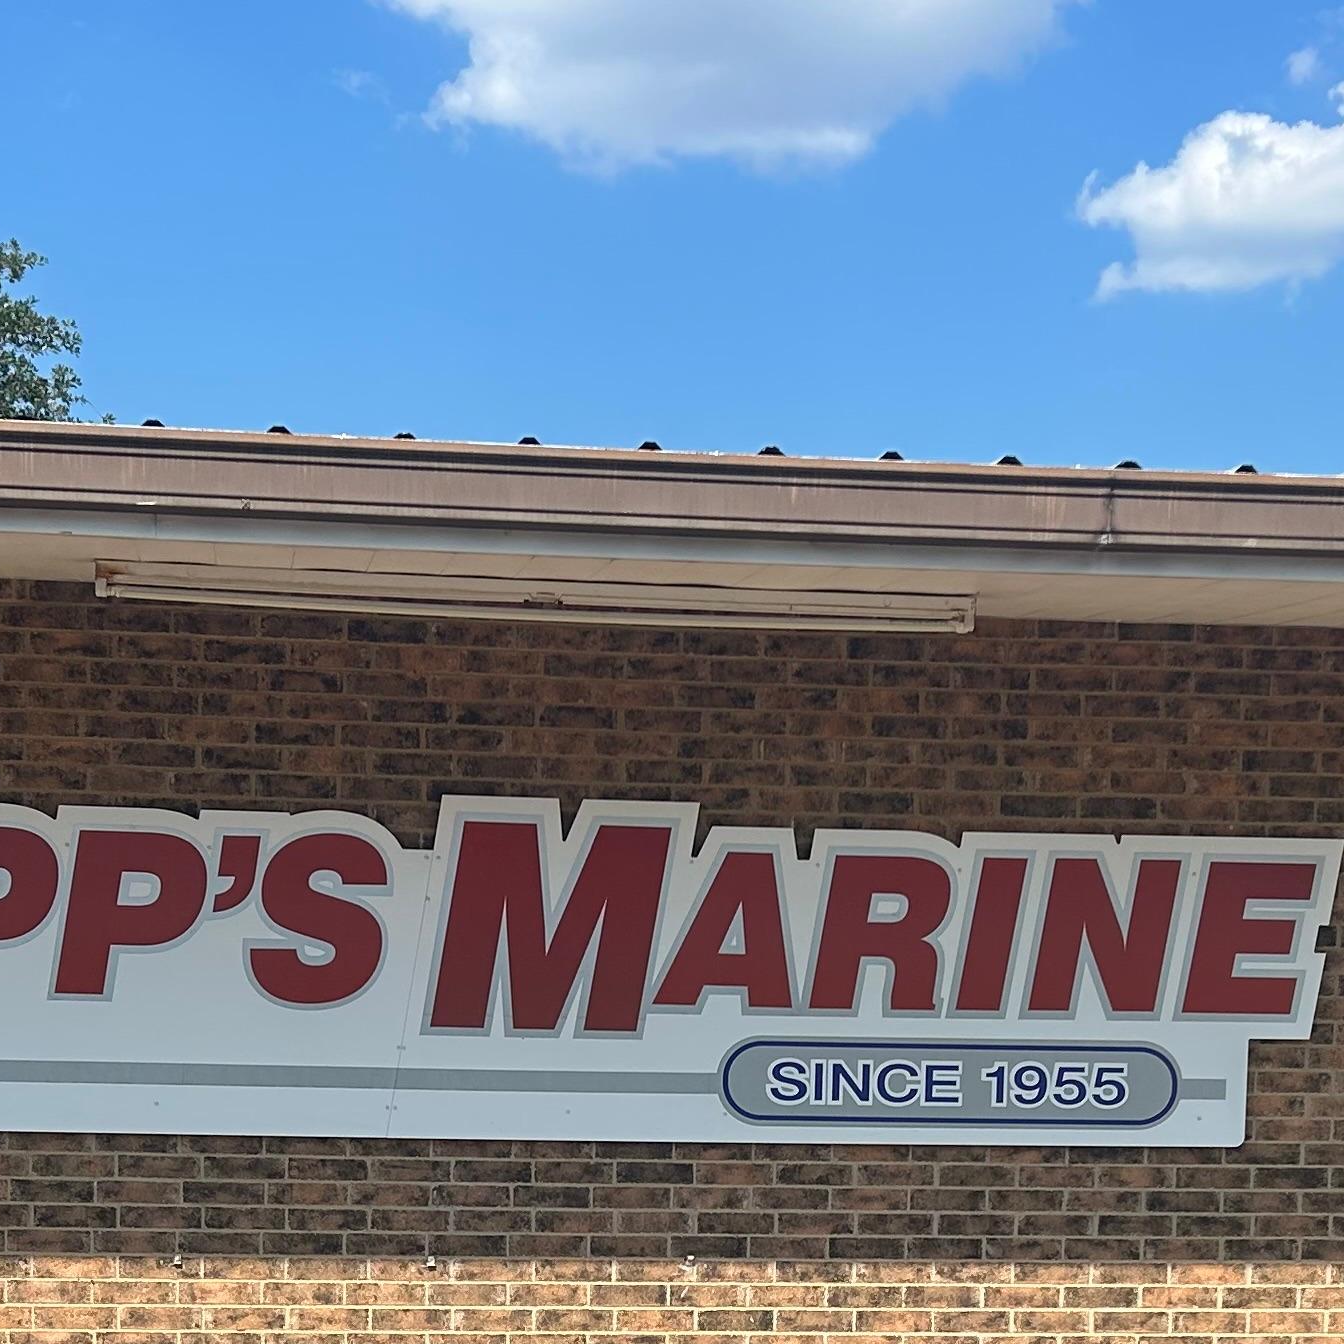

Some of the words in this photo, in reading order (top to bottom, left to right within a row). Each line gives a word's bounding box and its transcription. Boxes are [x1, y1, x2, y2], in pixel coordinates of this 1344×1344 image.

[429, 821, 1317, 1031] MARINE
[768, 1059, 960, 1106] SINCE
[981, 1064, 1129, 1108] 1955
